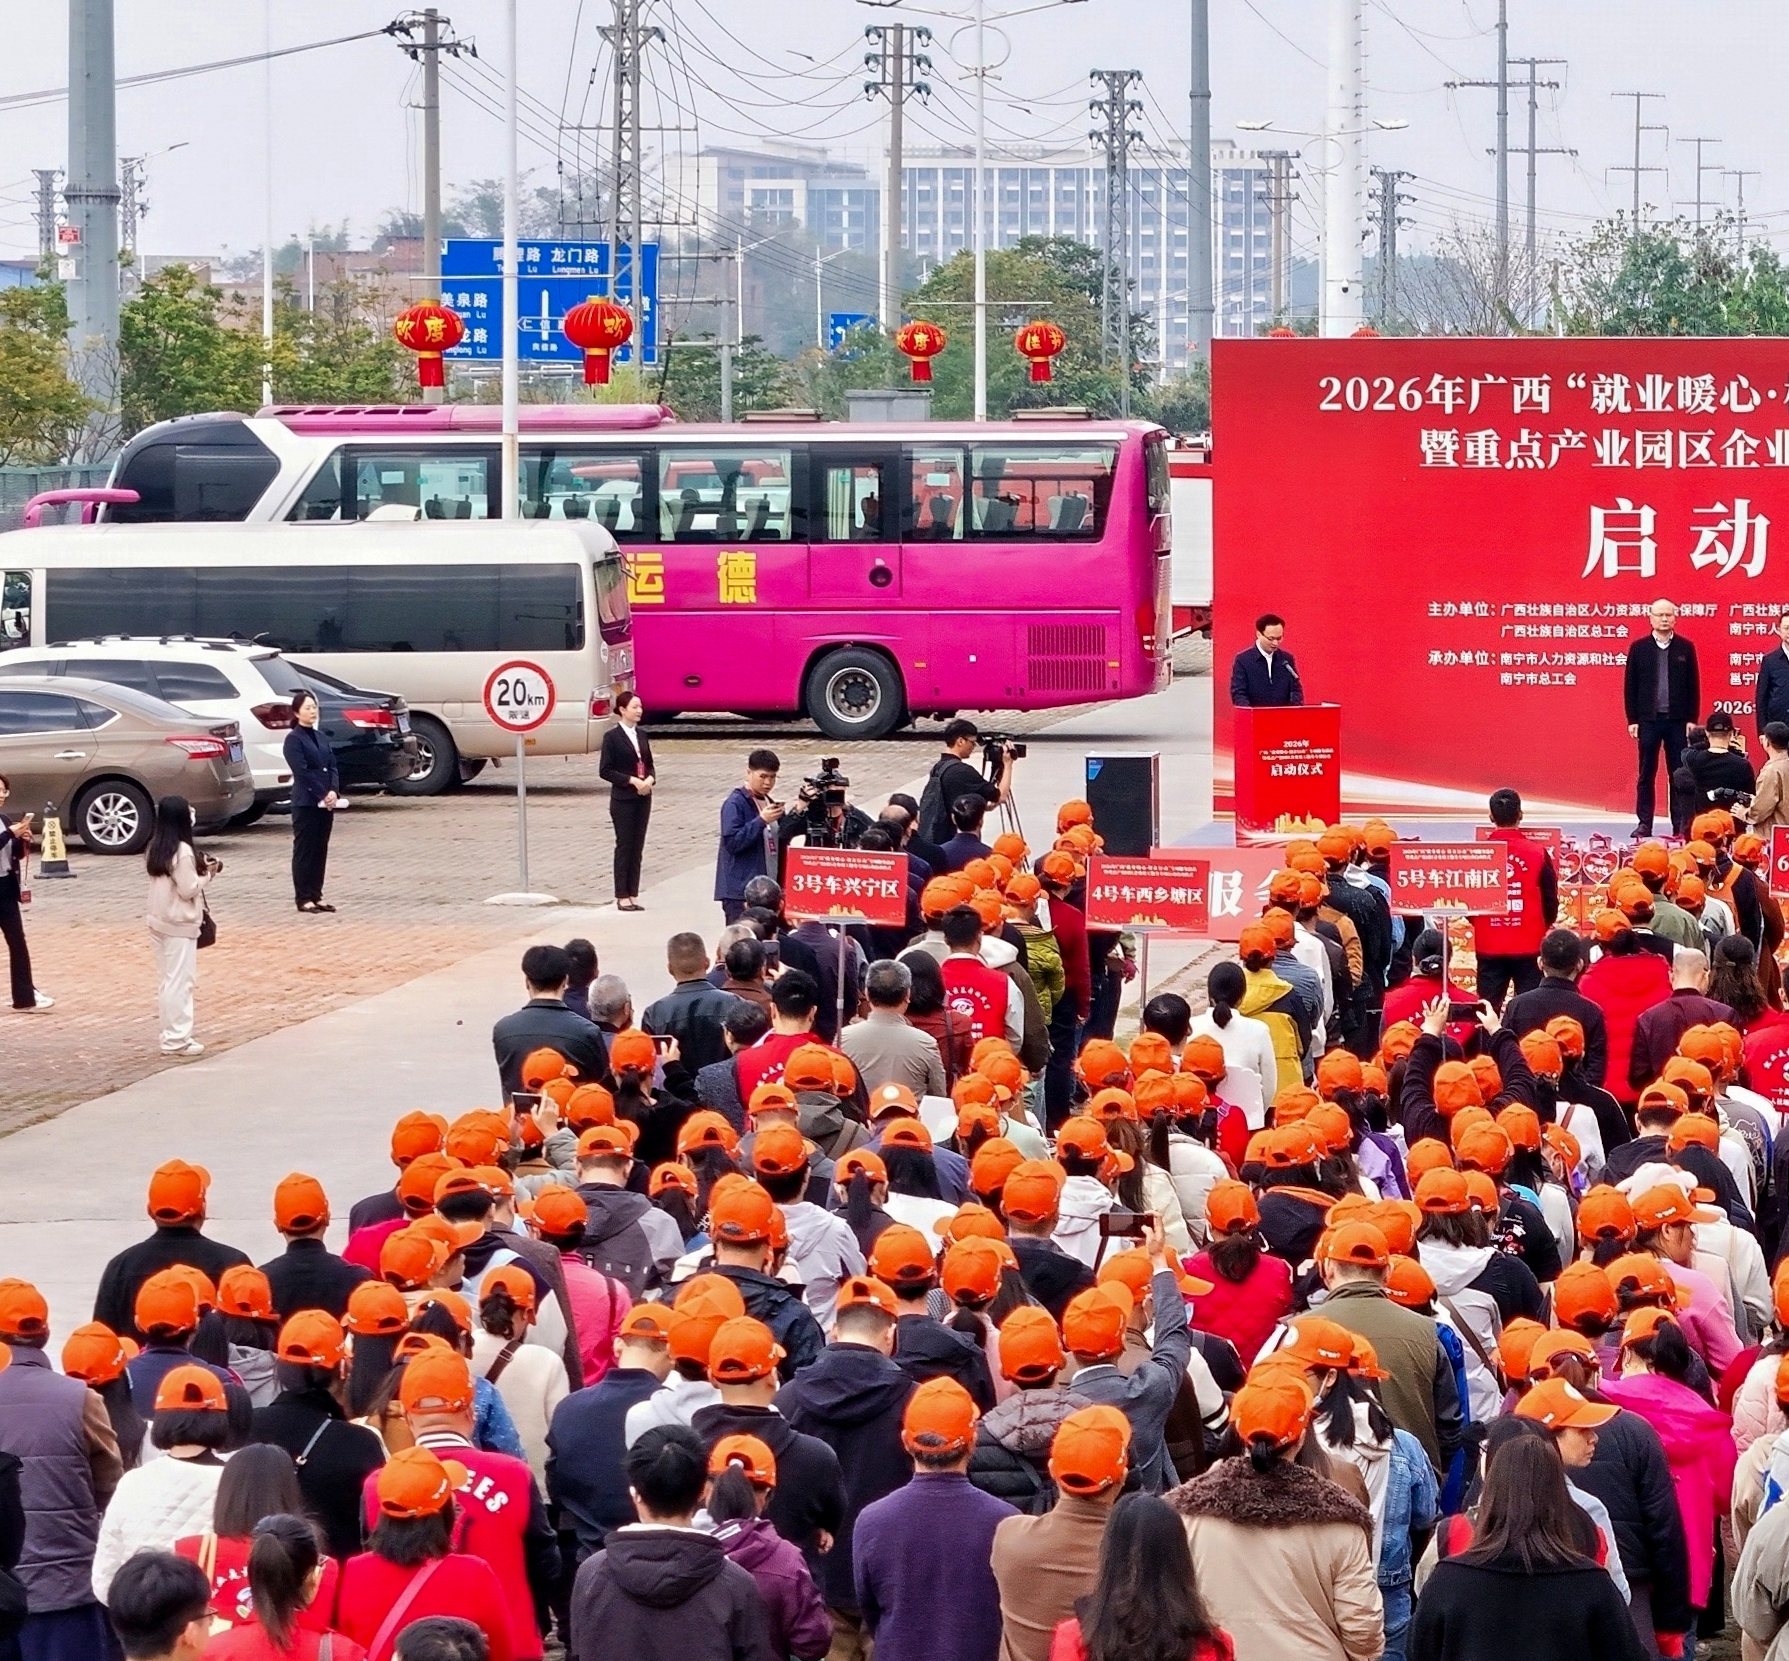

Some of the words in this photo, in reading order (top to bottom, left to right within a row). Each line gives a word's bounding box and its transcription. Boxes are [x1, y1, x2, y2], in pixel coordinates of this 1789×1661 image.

[551, 248, 599, 263] 龙门路
[440, 292, 488, 308] 美泉路
[1501, 602, 1718, 617] 广西壮族自治区人力资源和保障厅
[1501, 623, 1629, 638] 广西壮族自治区总工会
[1500, 671, 1577, 686] 南宁市总工会
[1713, 700, 1757, 715] 2026
[1271, 762, 1323, 777] 启动仪式
[792, 873, 900, 898] 3号车兴宁区
[1396, 868, 1502, 890] 5号车江南区
[1091, 885, 1204, 905] 4号车西乡塘区
